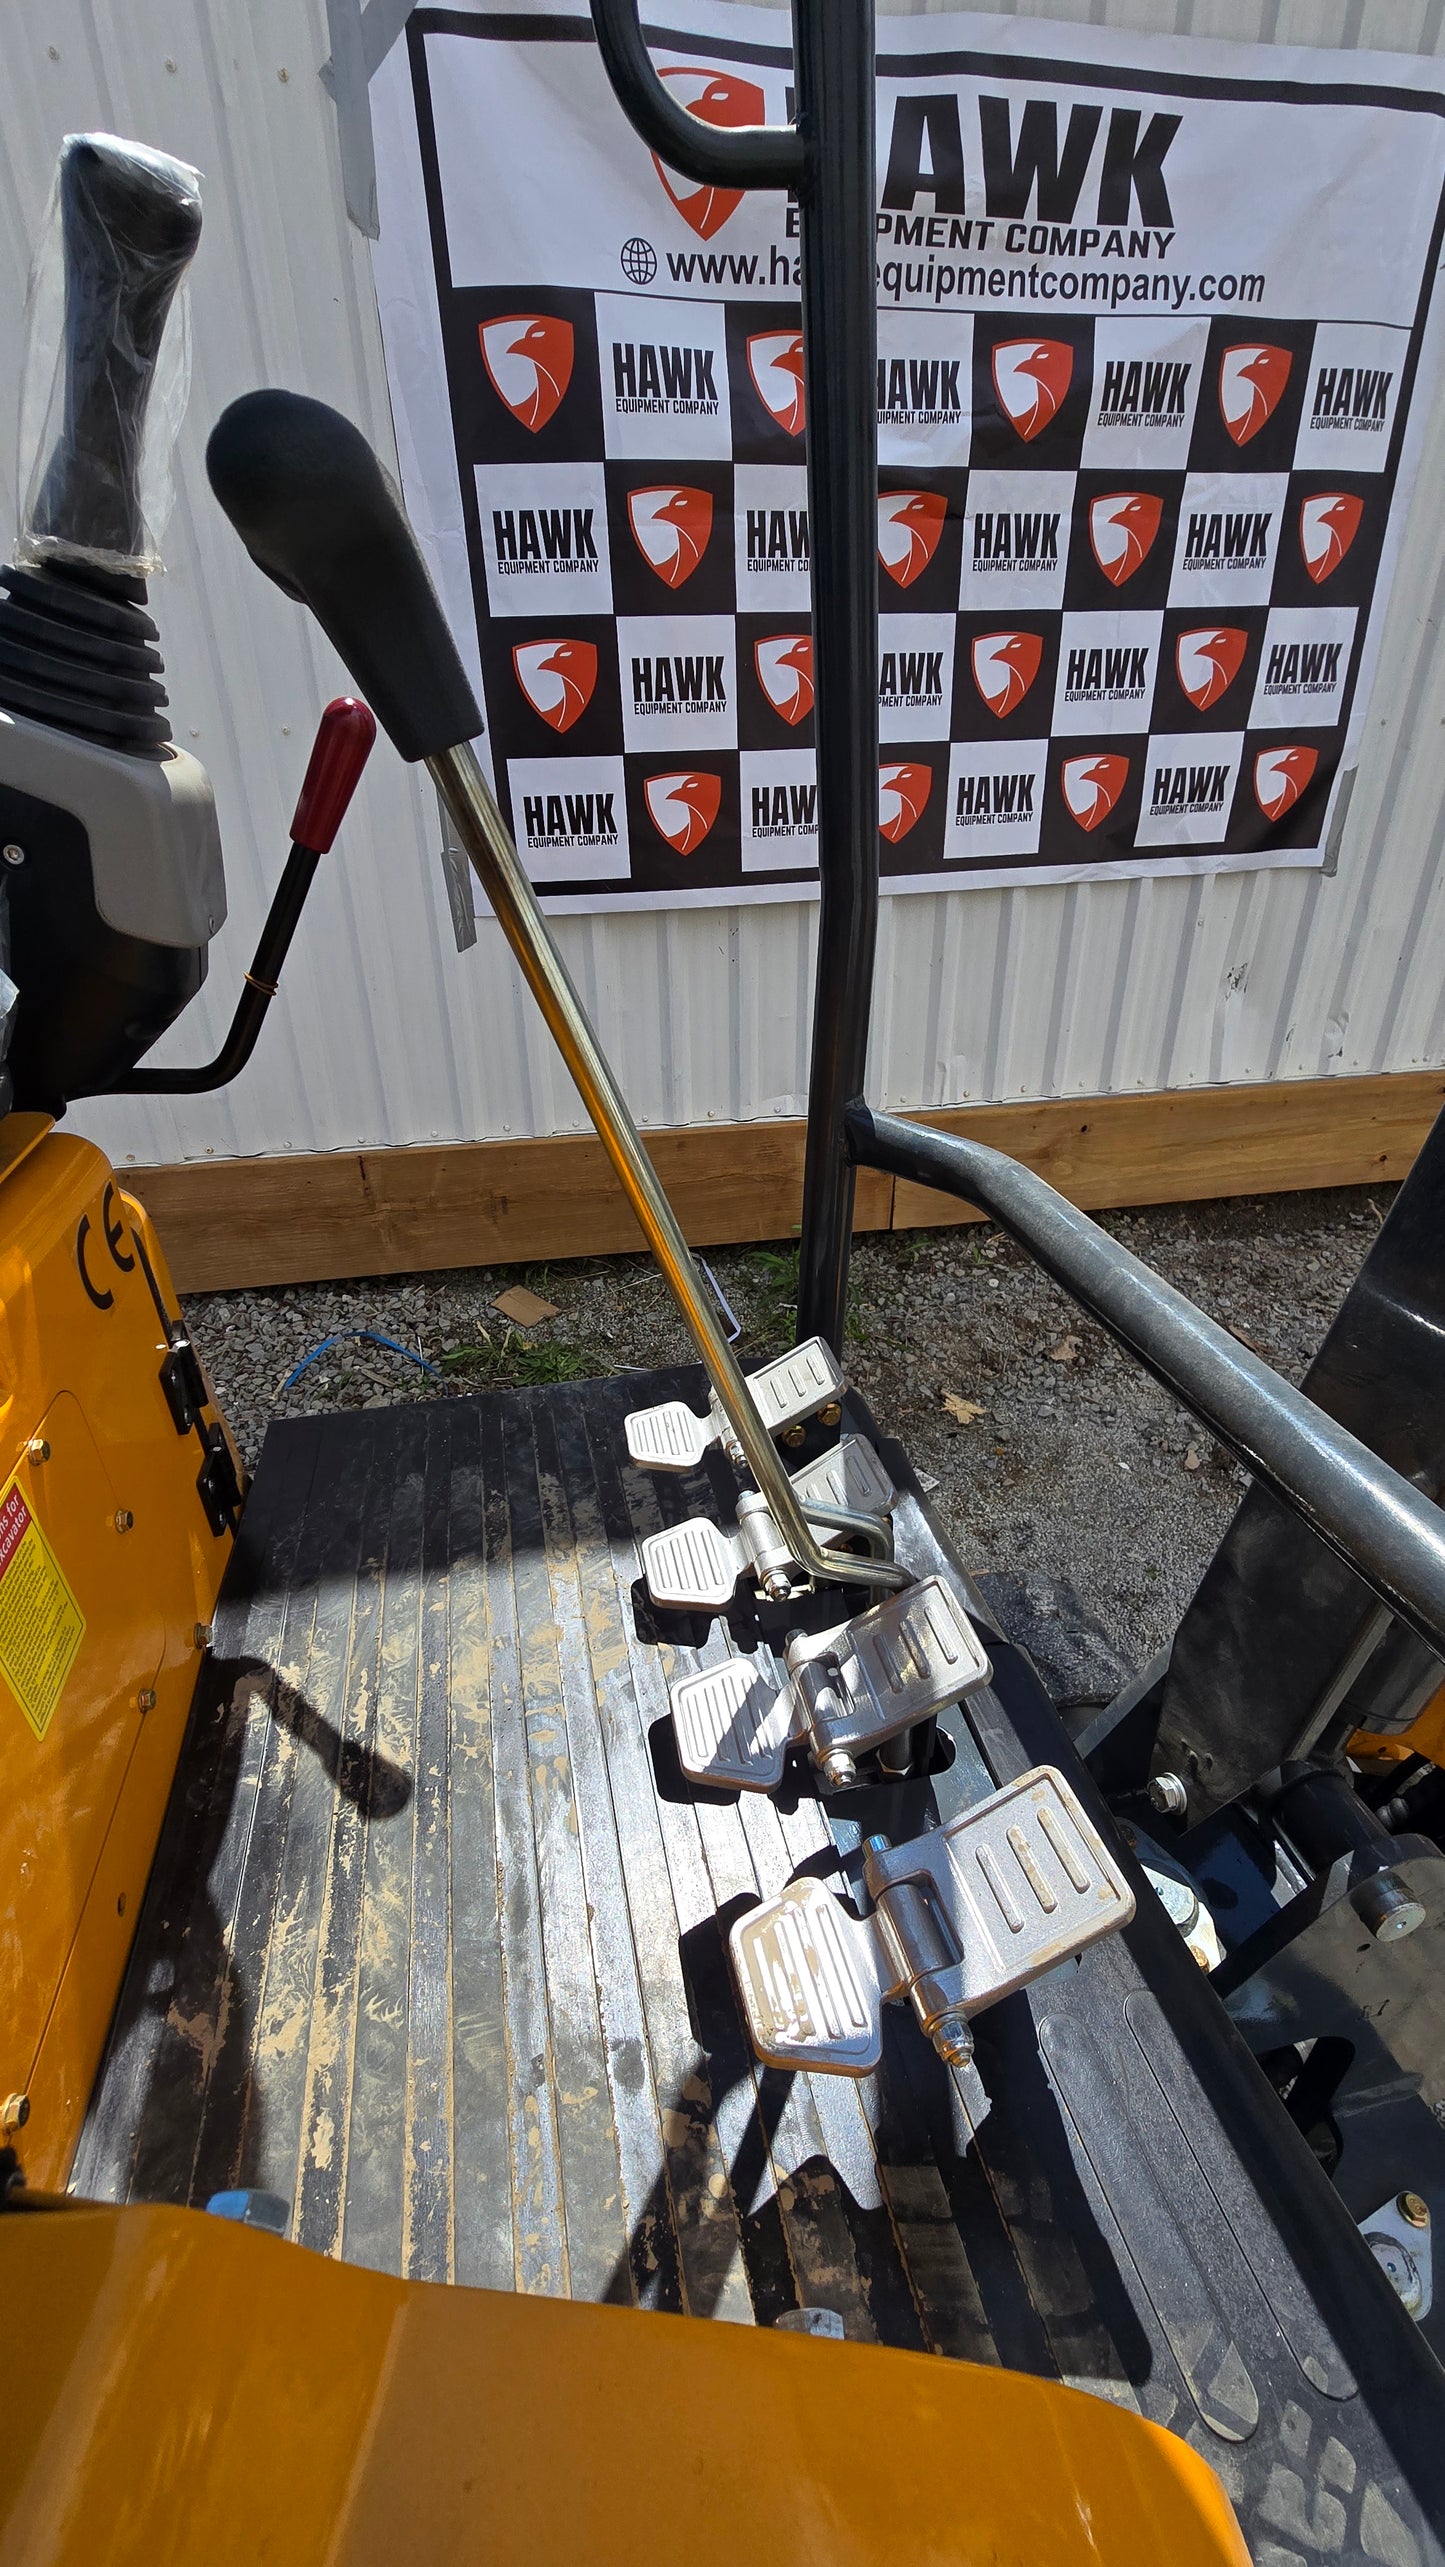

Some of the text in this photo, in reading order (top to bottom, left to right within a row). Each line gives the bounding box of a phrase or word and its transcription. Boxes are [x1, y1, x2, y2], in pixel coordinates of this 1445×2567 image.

[785, 87, 1183, 229] AWK
[786, 207, 1176, 260] EPMENT COMPANY
[613, 343, 718, 400] HAWK
[1101, 361, 1192, 413] HAWK
[616, 399, 718, 415] EQUIPMENT COMPANY
[1313, 368, 1393, 419] HAWK
[877, 411, 961, 424] UIPMENT COMPANY
[1097, 413, 1184, 427] EQUIPMENT COMPANY
[1310, 417, 1384, 431] EQUIPMENT COMPANY
[493, 509, 598, 560] HAWK
[747, 510, 811, 558] HAW
[974, 513, 1060, 558] HAWK
[1185, 513, 1272, 557] HAWK
[498, 560, 598, 575] EQUIPMENT COMPANY
[747, 559, 795, 573] EQUIPMENT
[973, 560, 1058, 572] EQUIPMENT COMPANY
[1183, 558, 1266, 571] EQUIPMENT COMPANY
[632, 656, 726, 702] HAWK
[879, 652, 944, 695] AWK
[1066, 648, 1149, 690] HAWK
[1266, 643, 1343, 684] HAWK
[634, 701, 726, 715] EQUIPMENT COMPANY
[905, 694, 943, 707] COMPANY
[1065, 689, 1145, 702] EQUIPMENT COMPANY
[1264, 683, 1336, 695] EQUIPMENT COMPANY
[752, 785, 817, 826] HAW
[957, 774, 1035, 815] HAWK
[1152, 766, 1230, 805] HAWK
[523, 794, 617, 836] HAWK
[956, 812, 1033, 826] EQUIPMENT COMPANY
[1150, 803, 1223, 816] EQUIPMENT COMPANY
[528, 835, 618, 848] EQUIPMENT COMPANY
[752, 826, 796, 838] EQUIPMENT
[77, 1180, 135, 1310] CE
[6, 1494, 19, 1517] for
[0, 1506, 27, 1567] xcavator
